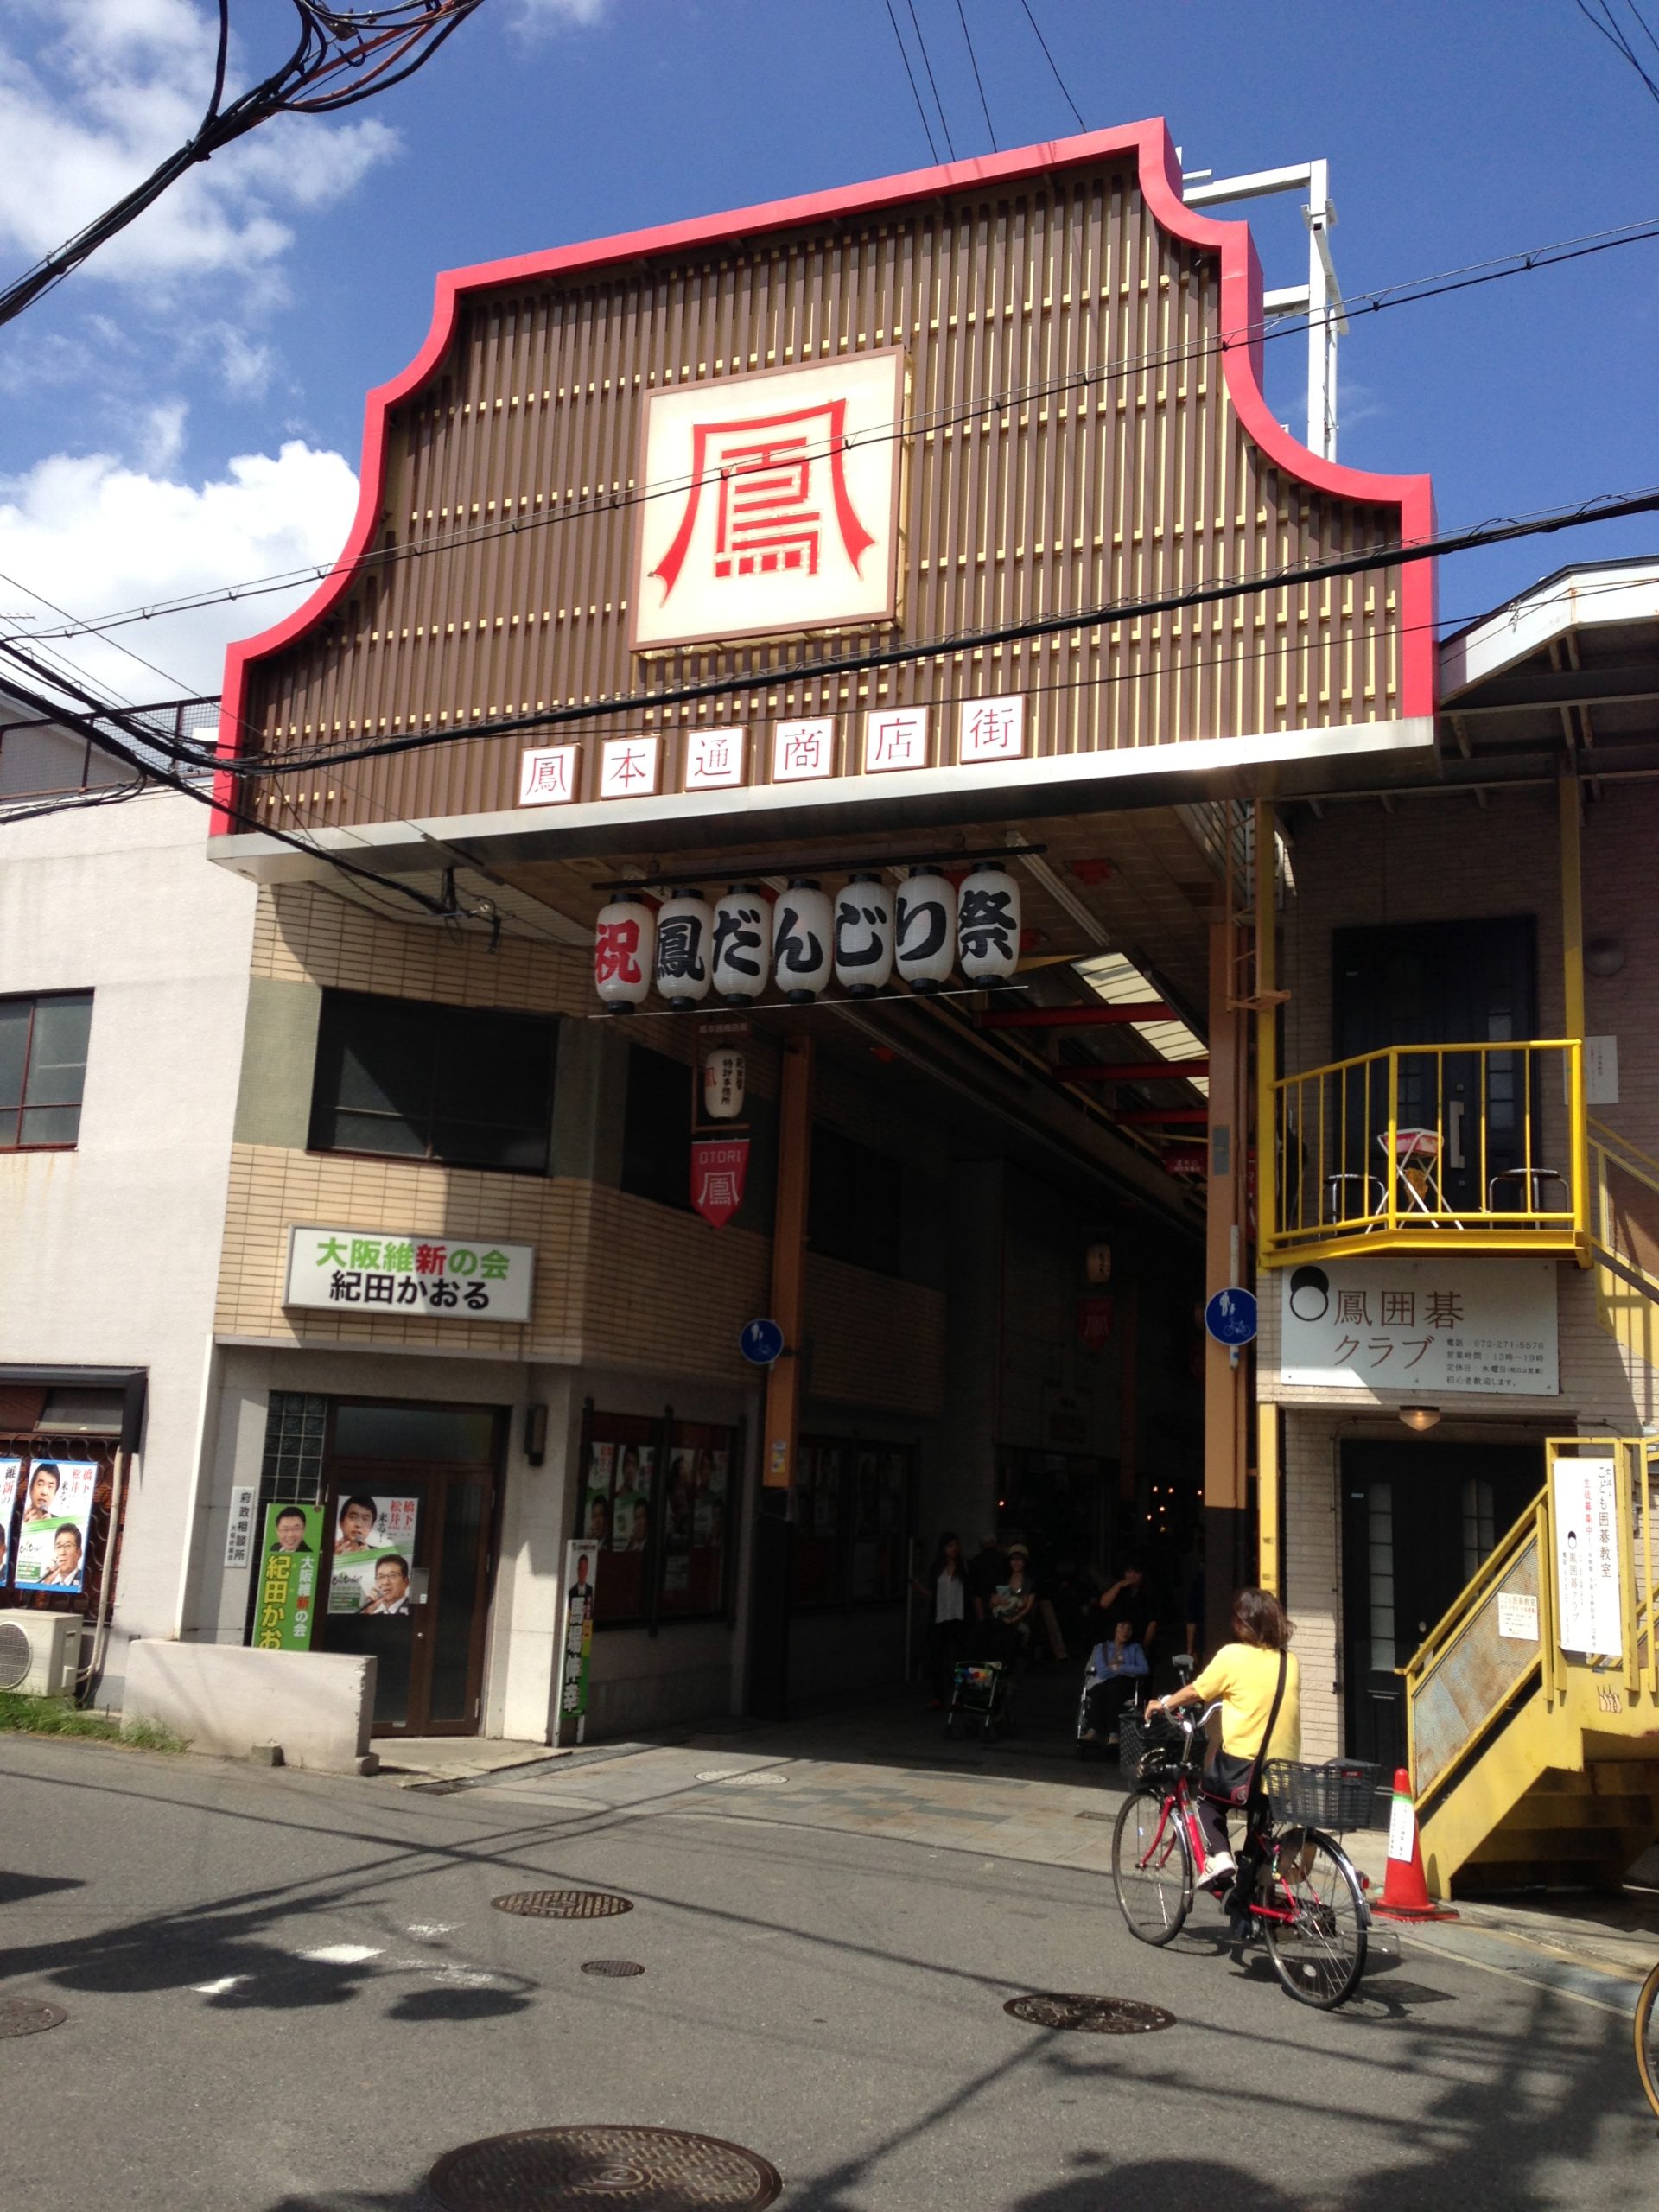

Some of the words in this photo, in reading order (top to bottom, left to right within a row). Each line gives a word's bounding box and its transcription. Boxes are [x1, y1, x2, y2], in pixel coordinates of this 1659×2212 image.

[651, 398, 877, 608] 鳳
[525, 707, 1014, 795] 鳳本通商店街
[699, 1150, 741, 1164] OTORI
[698, 1171, 740, 1207] 鳳
[316, 1237, 510, 1280] 大阪維新の会
[329, 1270, 490, 1310] 紀田かおる
[1334, 1290, 1465, 1329] 鳳囲碁
[1334, 1334, 1435, 1369] クラブ
[234, 1492, 251, 1561] 府政相談所
[293, 1555, 315, 1637] 大阪維新の会
